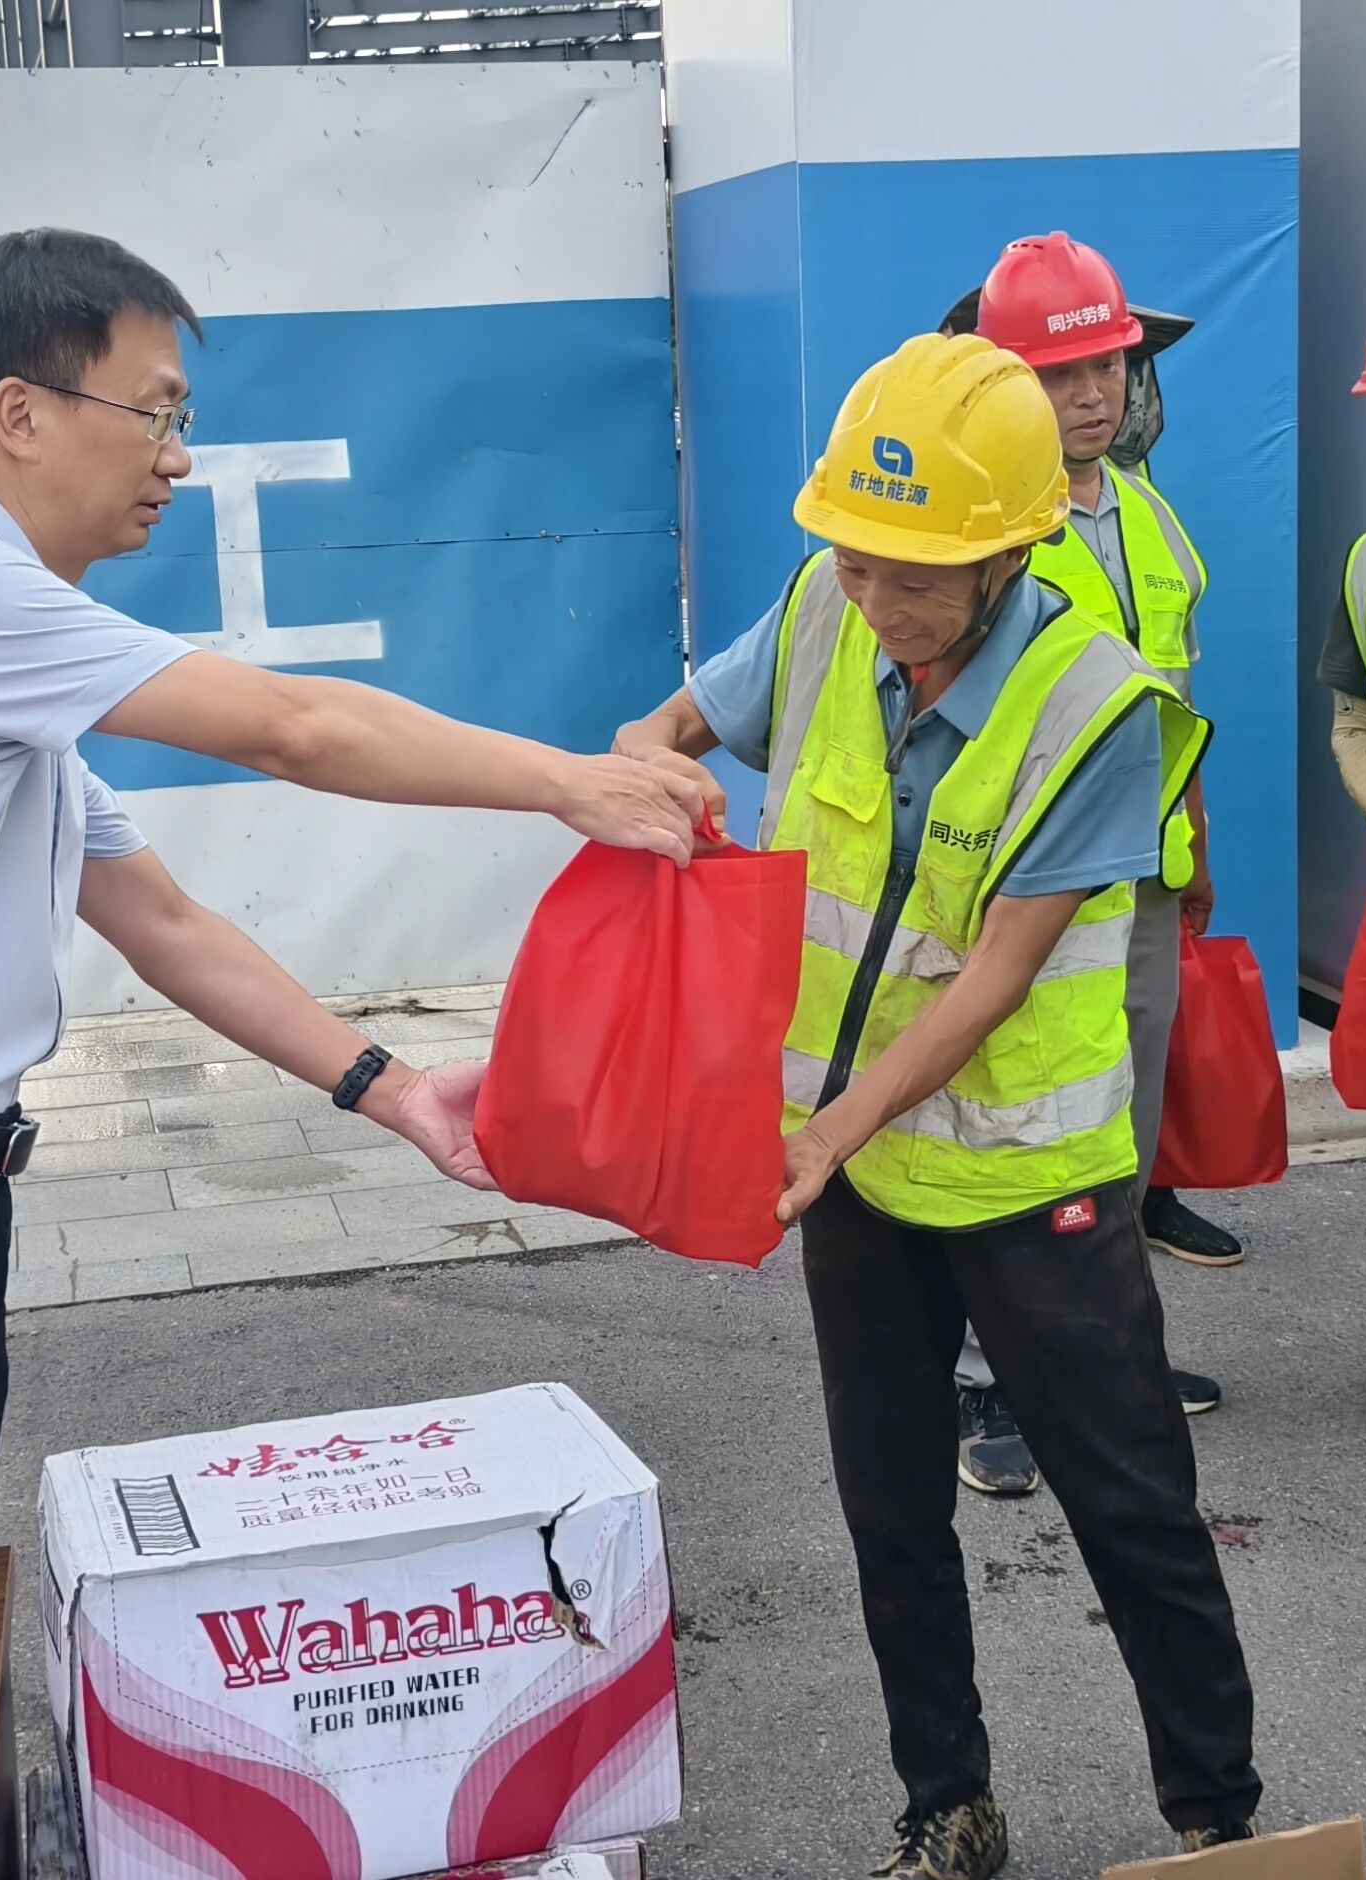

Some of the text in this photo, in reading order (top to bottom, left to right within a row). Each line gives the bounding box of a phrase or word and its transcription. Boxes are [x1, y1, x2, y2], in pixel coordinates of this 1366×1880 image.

[1047, 303, 1111, 334] 同兴劳务
[849, 469, 929, 505] 新地能源
[172, 438, 383, 667] 工
[1063, 1205, 1082, 1218] ZR
[196, 1421, 476, 1478] 娃哈哈
[278, 1458, 409, 1483] 饮用纯净水
[235, 1466, 472, 1513] 二十余年如一日
[241, 1482, 486, 1529] 质量经得起考验
[196, 1582, 592, 1690] Wahaha
[293, 1666, 481, 1712] PURIFIED WATER
[310, 1694, 464, 1734] FOR DRINKING
